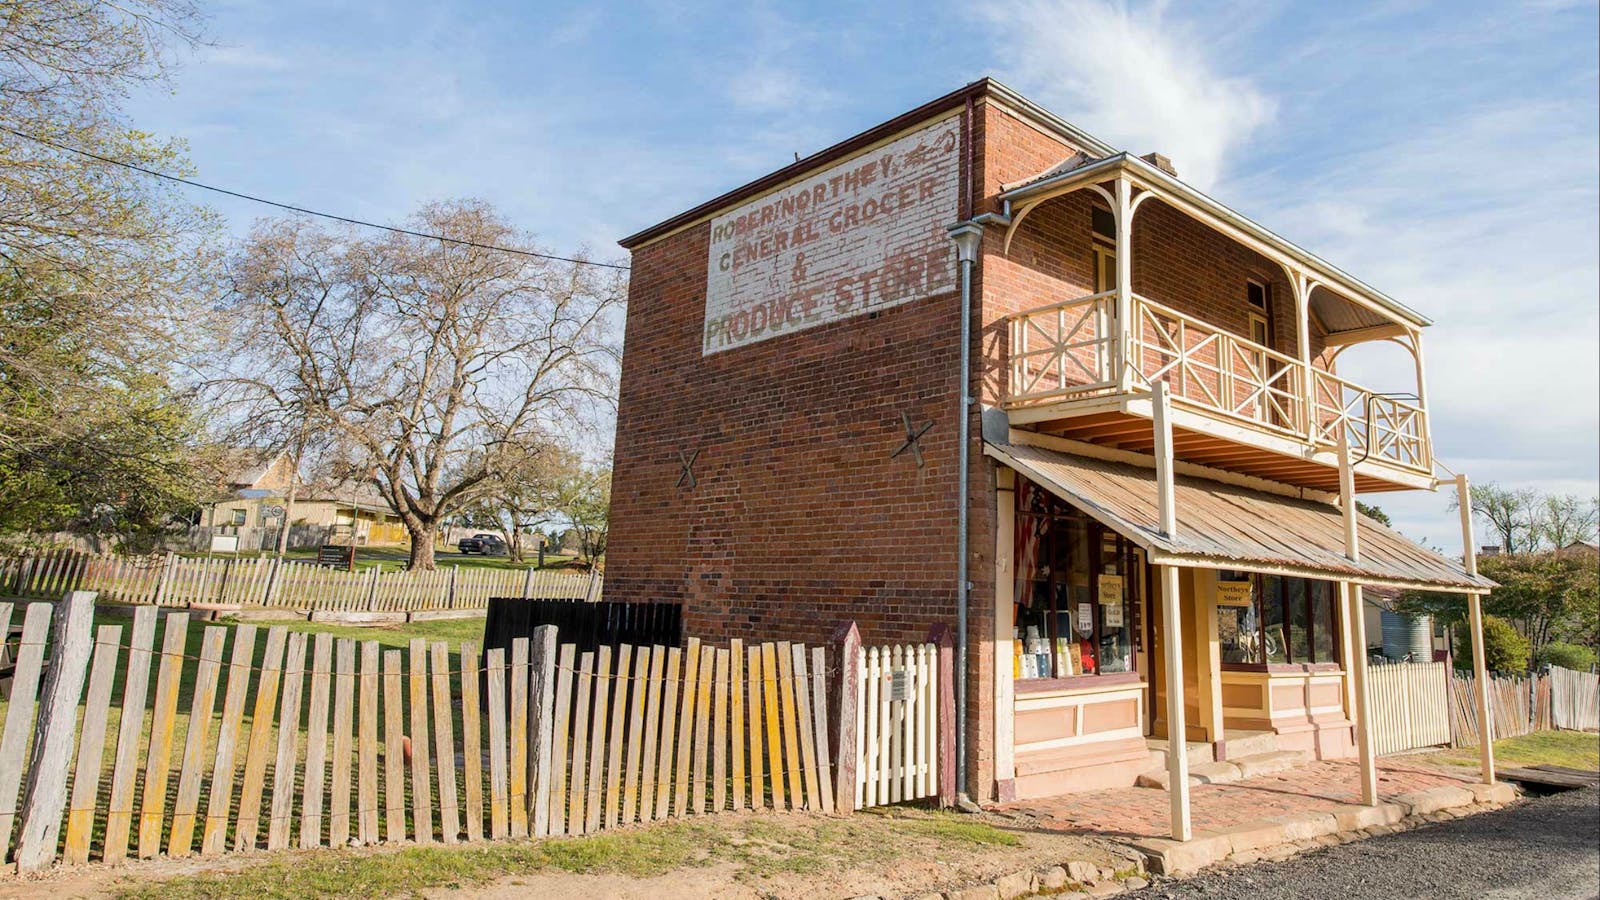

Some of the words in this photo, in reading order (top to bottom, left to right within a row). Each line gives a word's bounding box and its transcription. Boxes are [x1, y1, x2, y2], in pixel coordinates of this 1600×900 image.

[829, 177, 938, 234] GROCER
[792, 252, 810, 282] &
[706, 285, 824, 349] PRODUCE
[834, 249, 949, 314] STORE
